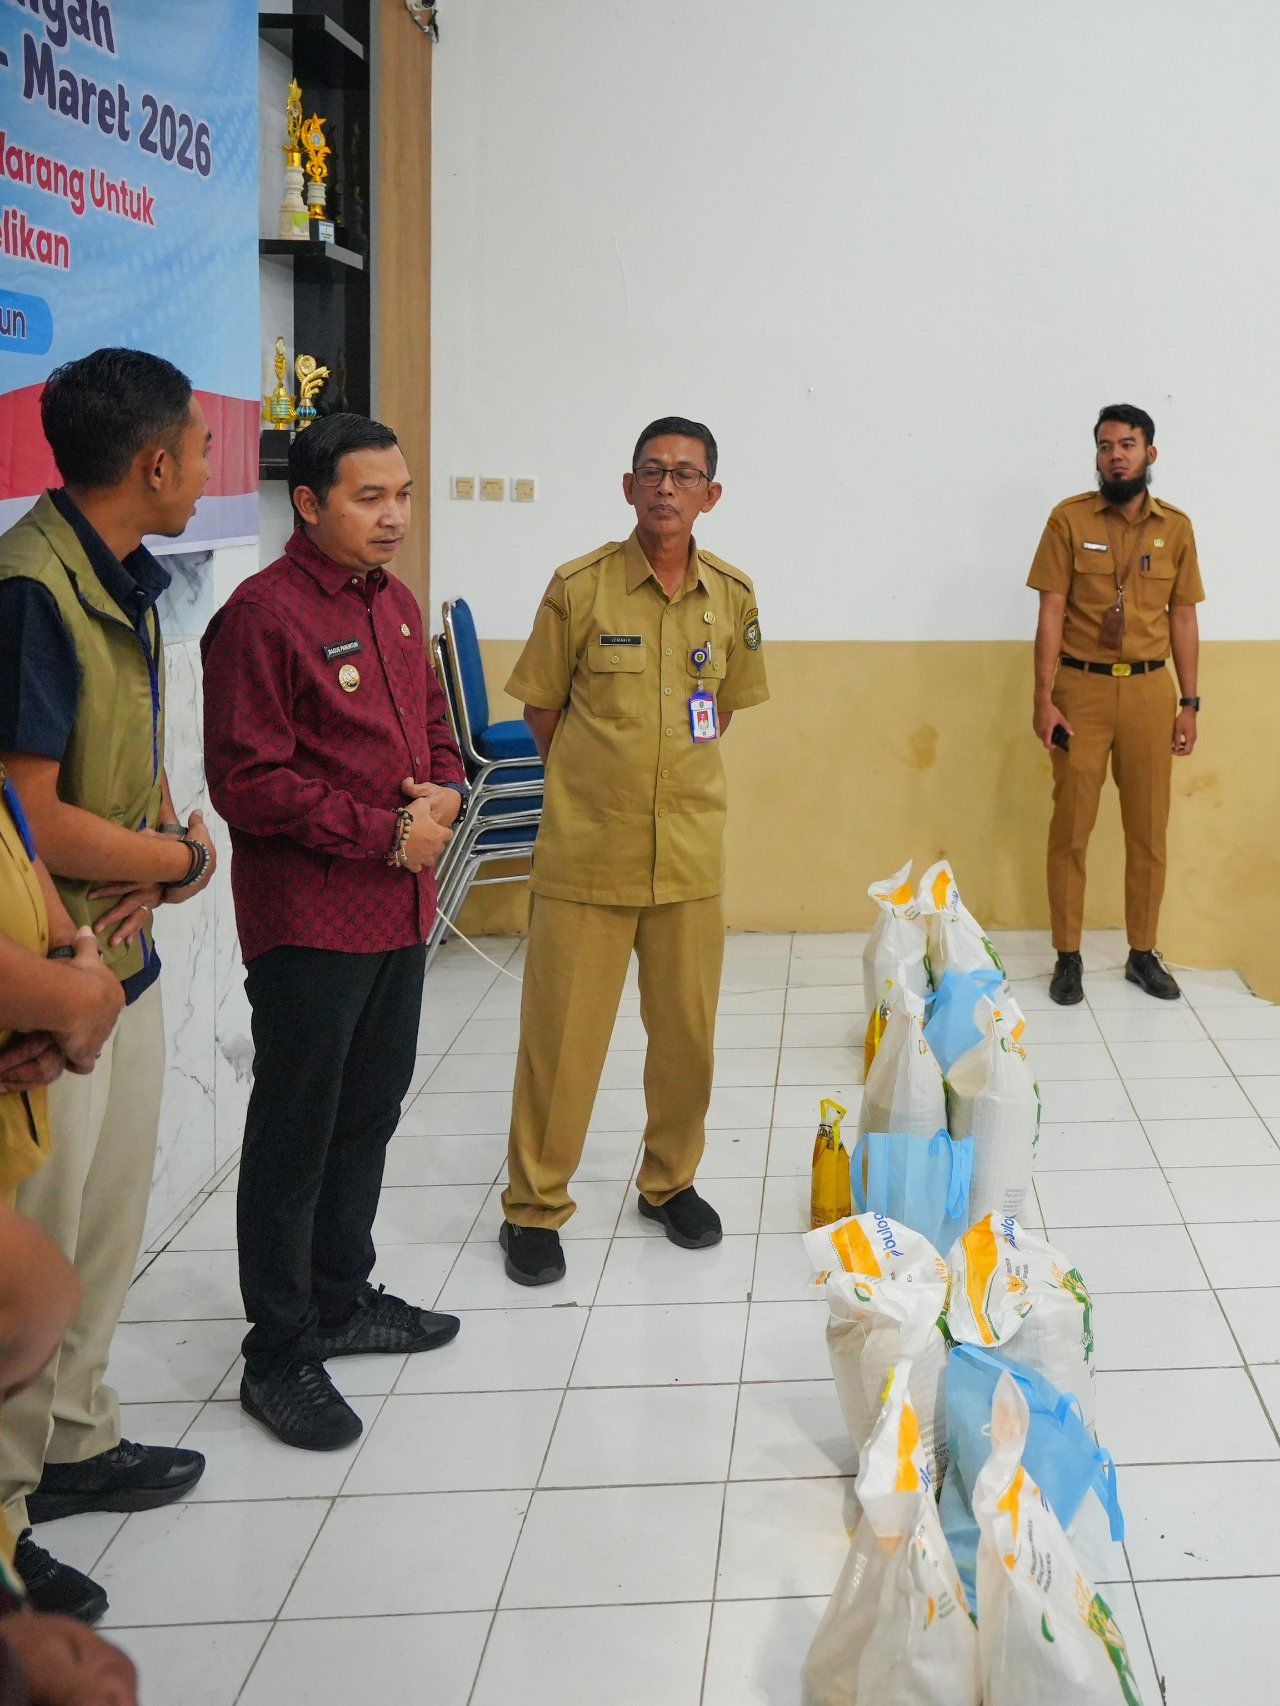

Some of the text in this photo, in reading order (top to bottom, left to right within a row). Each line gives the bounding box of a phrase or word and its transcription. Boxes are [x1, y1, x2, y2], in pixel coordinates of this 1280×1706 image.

[23, 33, 130, 142] Maret
[139, 94, 212, 176] 2026
[90, 168, 154, 225] Untuk
[0, 209, 69, 268] likan
